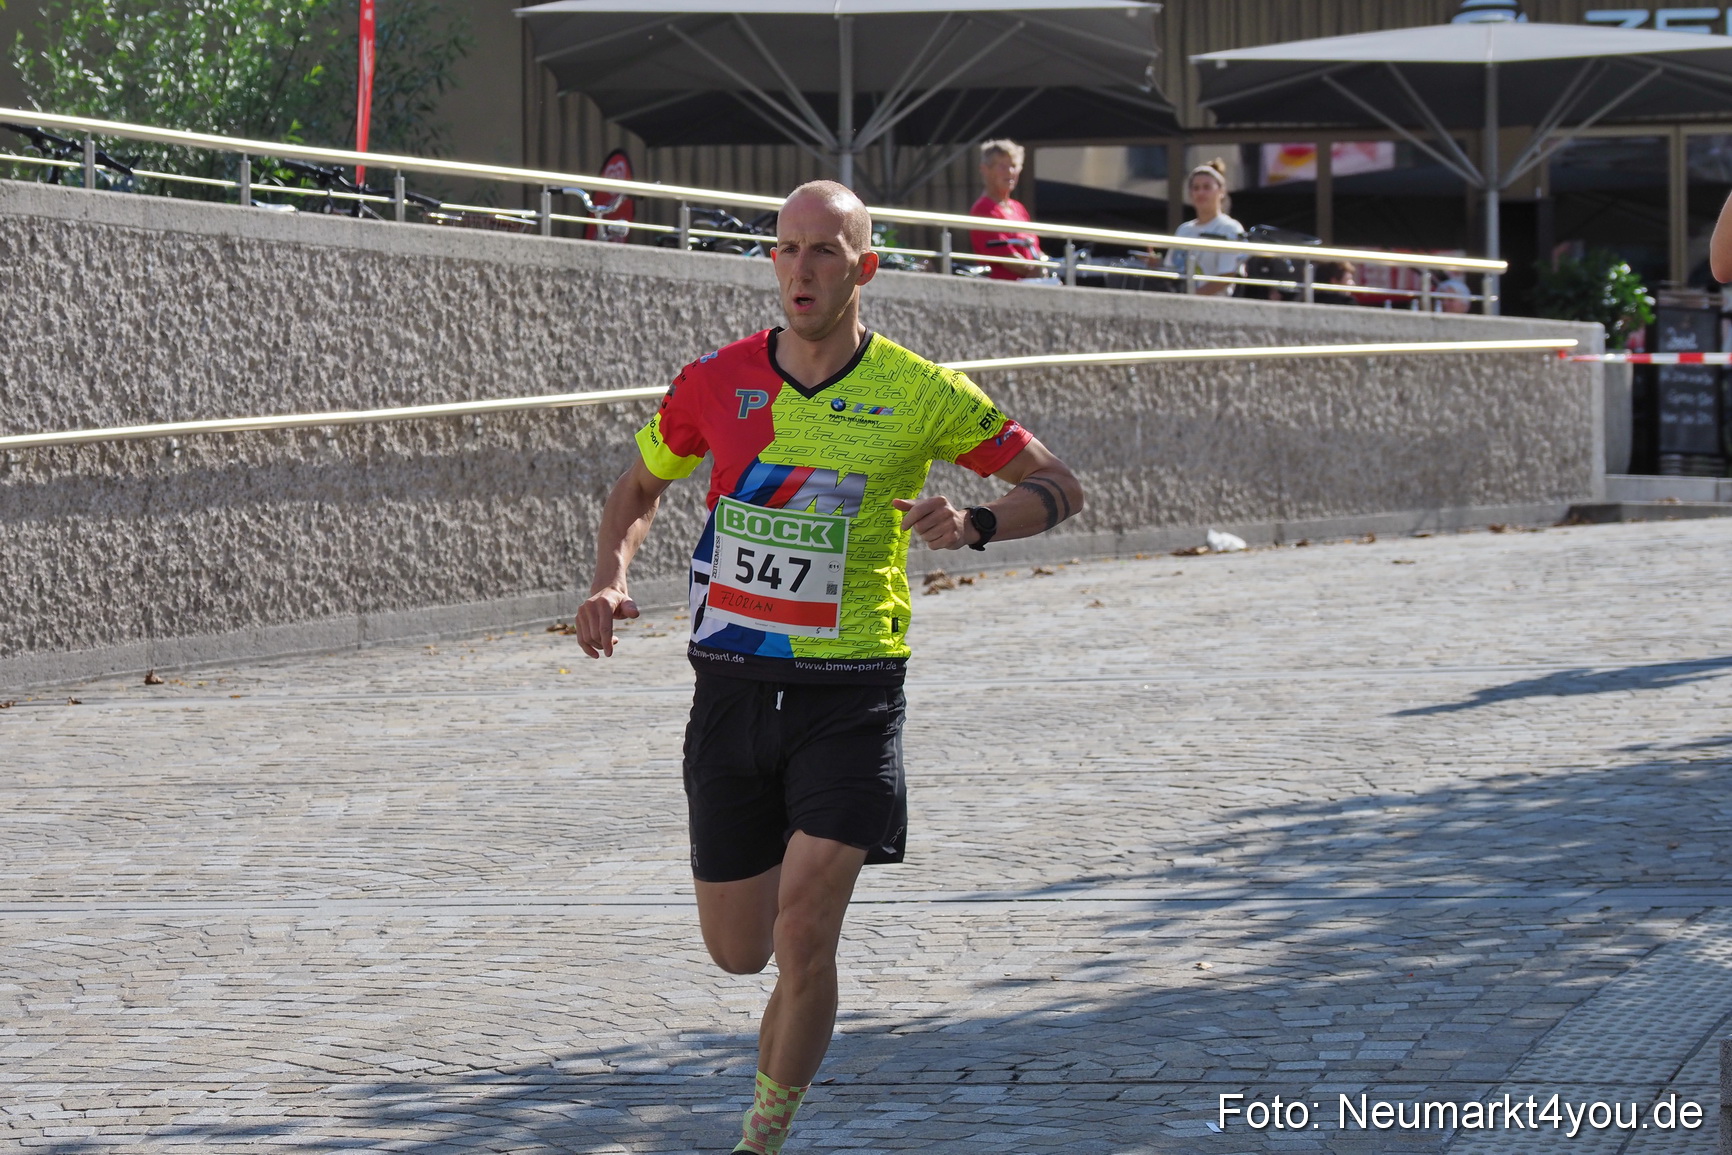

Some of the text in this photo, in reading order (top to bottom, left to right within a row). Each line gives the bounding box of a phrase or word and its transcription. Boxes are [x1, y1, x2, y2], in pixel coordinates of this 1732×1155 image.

[724, 504, 834, 549] BOCK
[735, 546, 812, 593] 547
[720, 590, 774, 613] FLORIAN
[794, 661, 897, 673] www.bmw-partl.de
